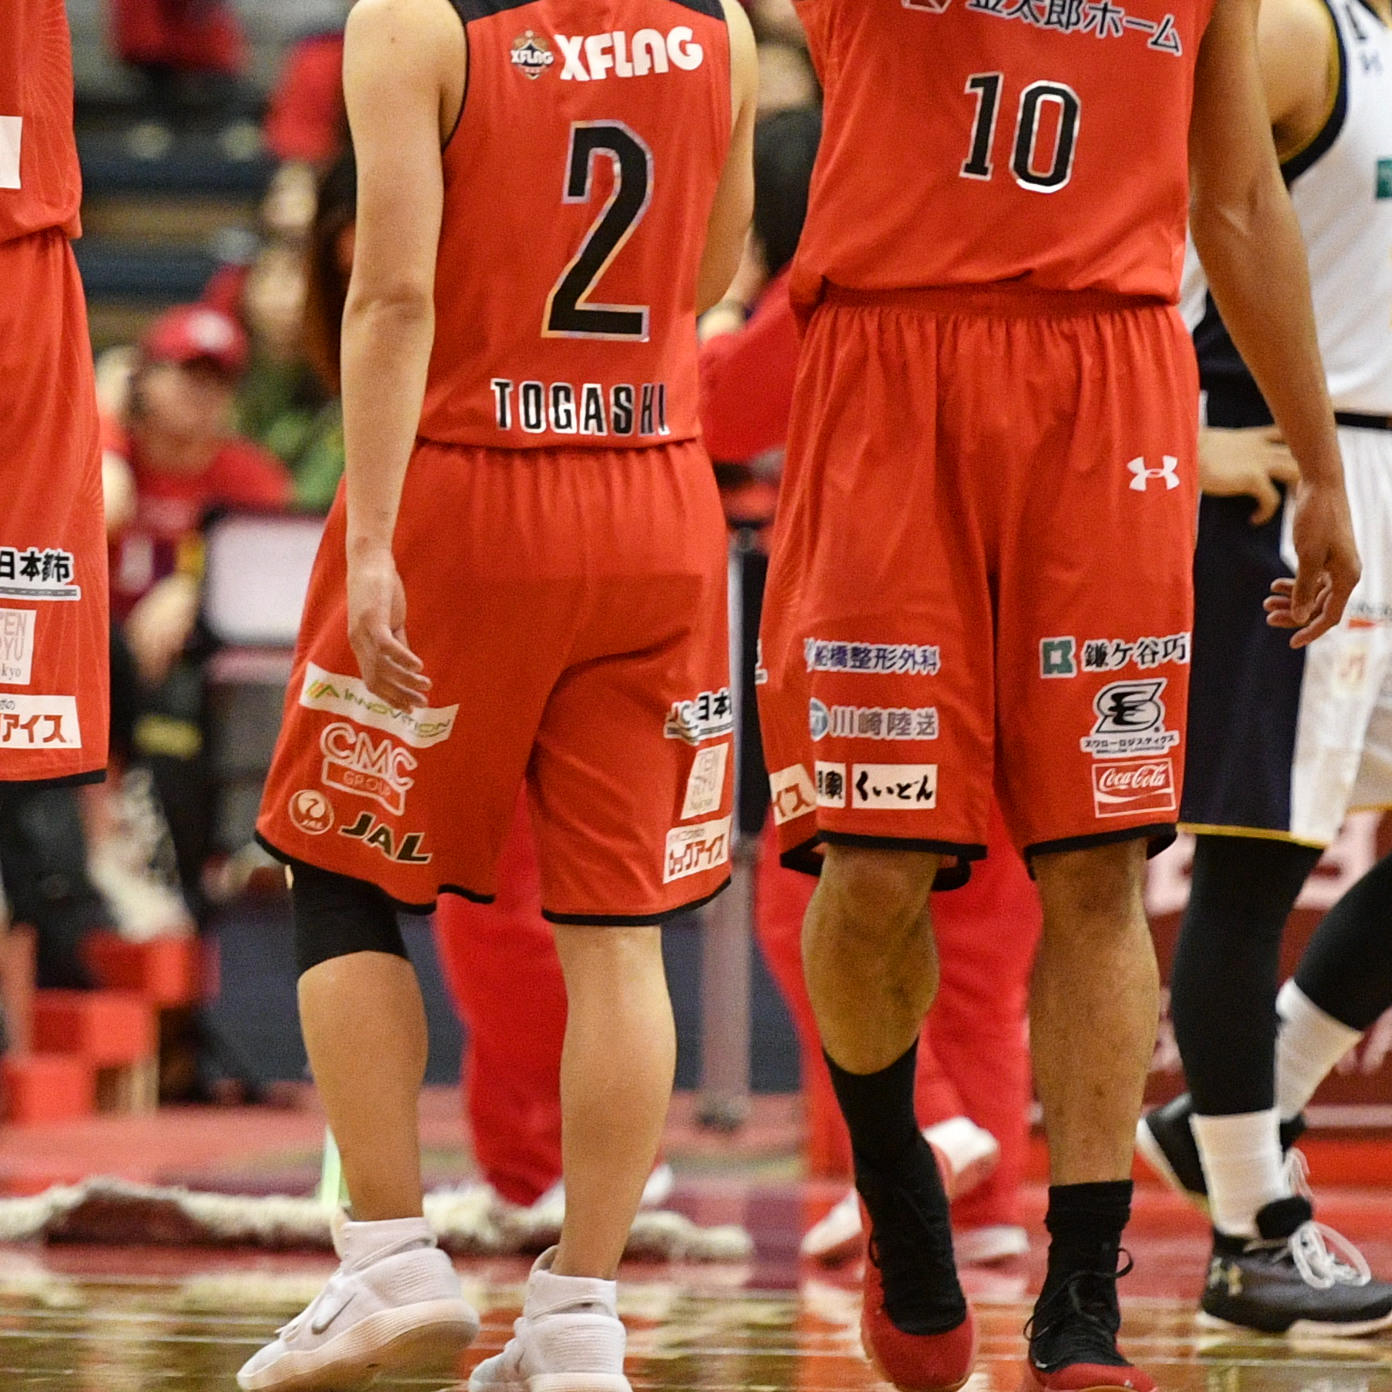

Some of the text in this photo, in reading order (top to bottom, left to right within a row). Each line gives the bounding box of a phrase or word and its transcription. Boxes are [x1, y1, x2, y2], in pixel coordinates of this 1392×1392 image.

[510, 49, 555, 66] XFLAG
[554, 25, 705, 82] XFLAG
[959, 71, 1082, 194] 10
[540, 118, 655, 343] 2
[489, 377, 670, 437] TOGASHI
[319, 721, 419, 792] CMC
[343, 771, 391, 796] GROUP
[855, 770, 934, 803] くいどん
[338, 811, 433, 865] JAL
